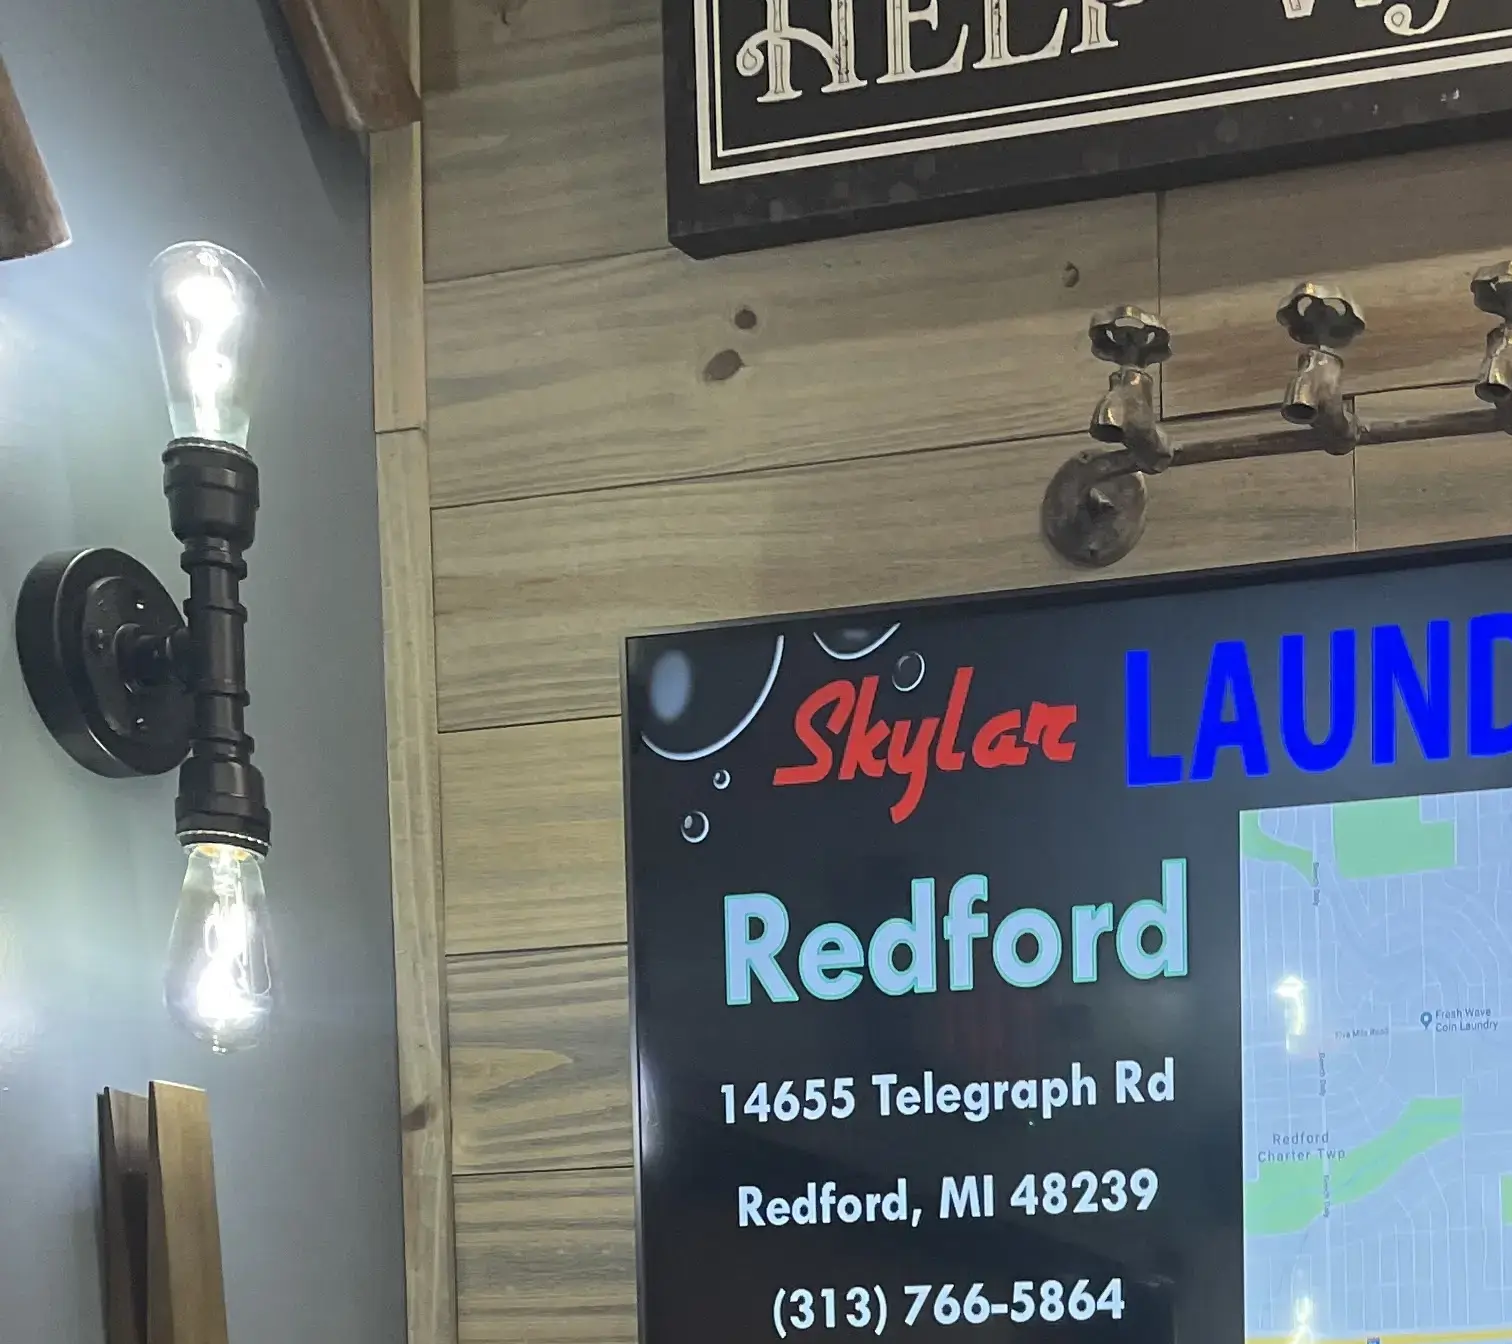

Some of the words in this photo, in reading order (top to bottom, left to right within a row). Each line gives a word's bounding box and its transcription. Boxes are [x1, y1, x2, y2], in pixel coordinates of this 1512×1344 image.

[773, 666, 1078, 823] Skylar
[724, 858, 1188, 1006] Redford
[1435, 1009, 1462, 1019] Fresh
[1465, 1007, 1491, 1018] Wave
[1435, 1023, 1456, 1033] Coin
[1460, 1020, 1499, 1032] Laundry
[721, 1077, 855, 1124] 14655
[872, 1064, 1096, 1122] Telegraph
[1117, 1058, 1175, 1103] Rd
[1258, 1149, 1310, 1163] Charter
[1317, 1148, 1345, 1161] Twp
[1272, 1131, 1330, 1145] Redford
[738, 1178, 921, 1230] Redford,
[939, 1173, 993, 1219] MI
[1010, 1168, 1159, 1214] 48239
[772, 1285, 890, 1337] (313)
[904, 1278, 1126, 1326] 766-5864
